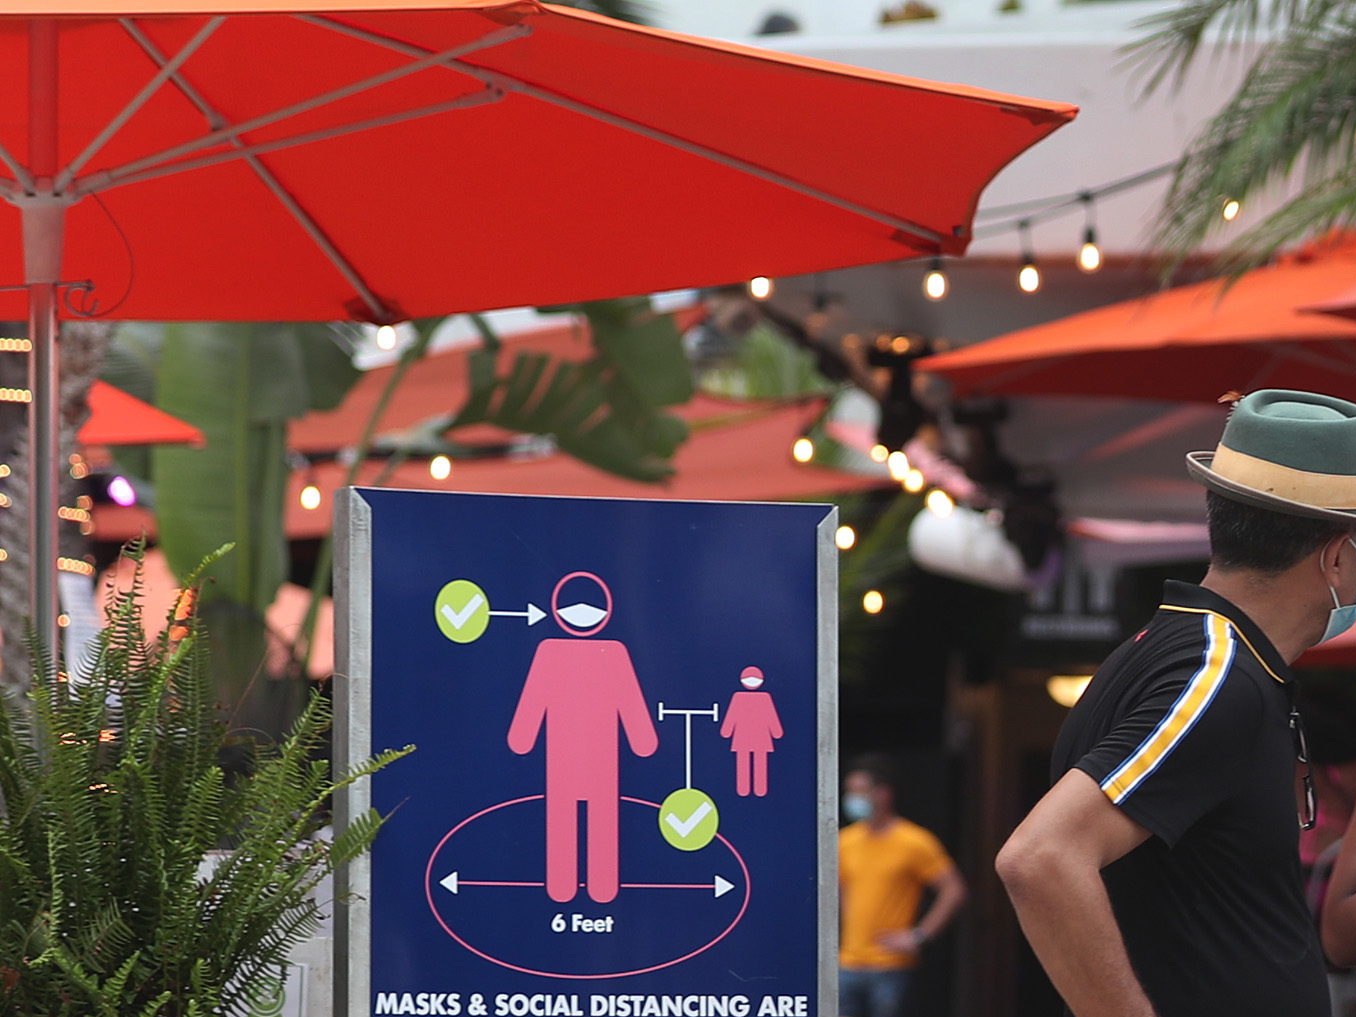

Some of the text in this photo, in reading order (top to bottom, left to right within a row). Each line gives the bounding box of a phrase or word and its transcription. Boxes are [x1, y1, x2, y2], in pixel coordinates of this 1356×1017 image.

[551, 914, 614, 933] 6 Feet
[375, 993, 808, 1017] MASKS & SOCIAL DISTANCING ARE
